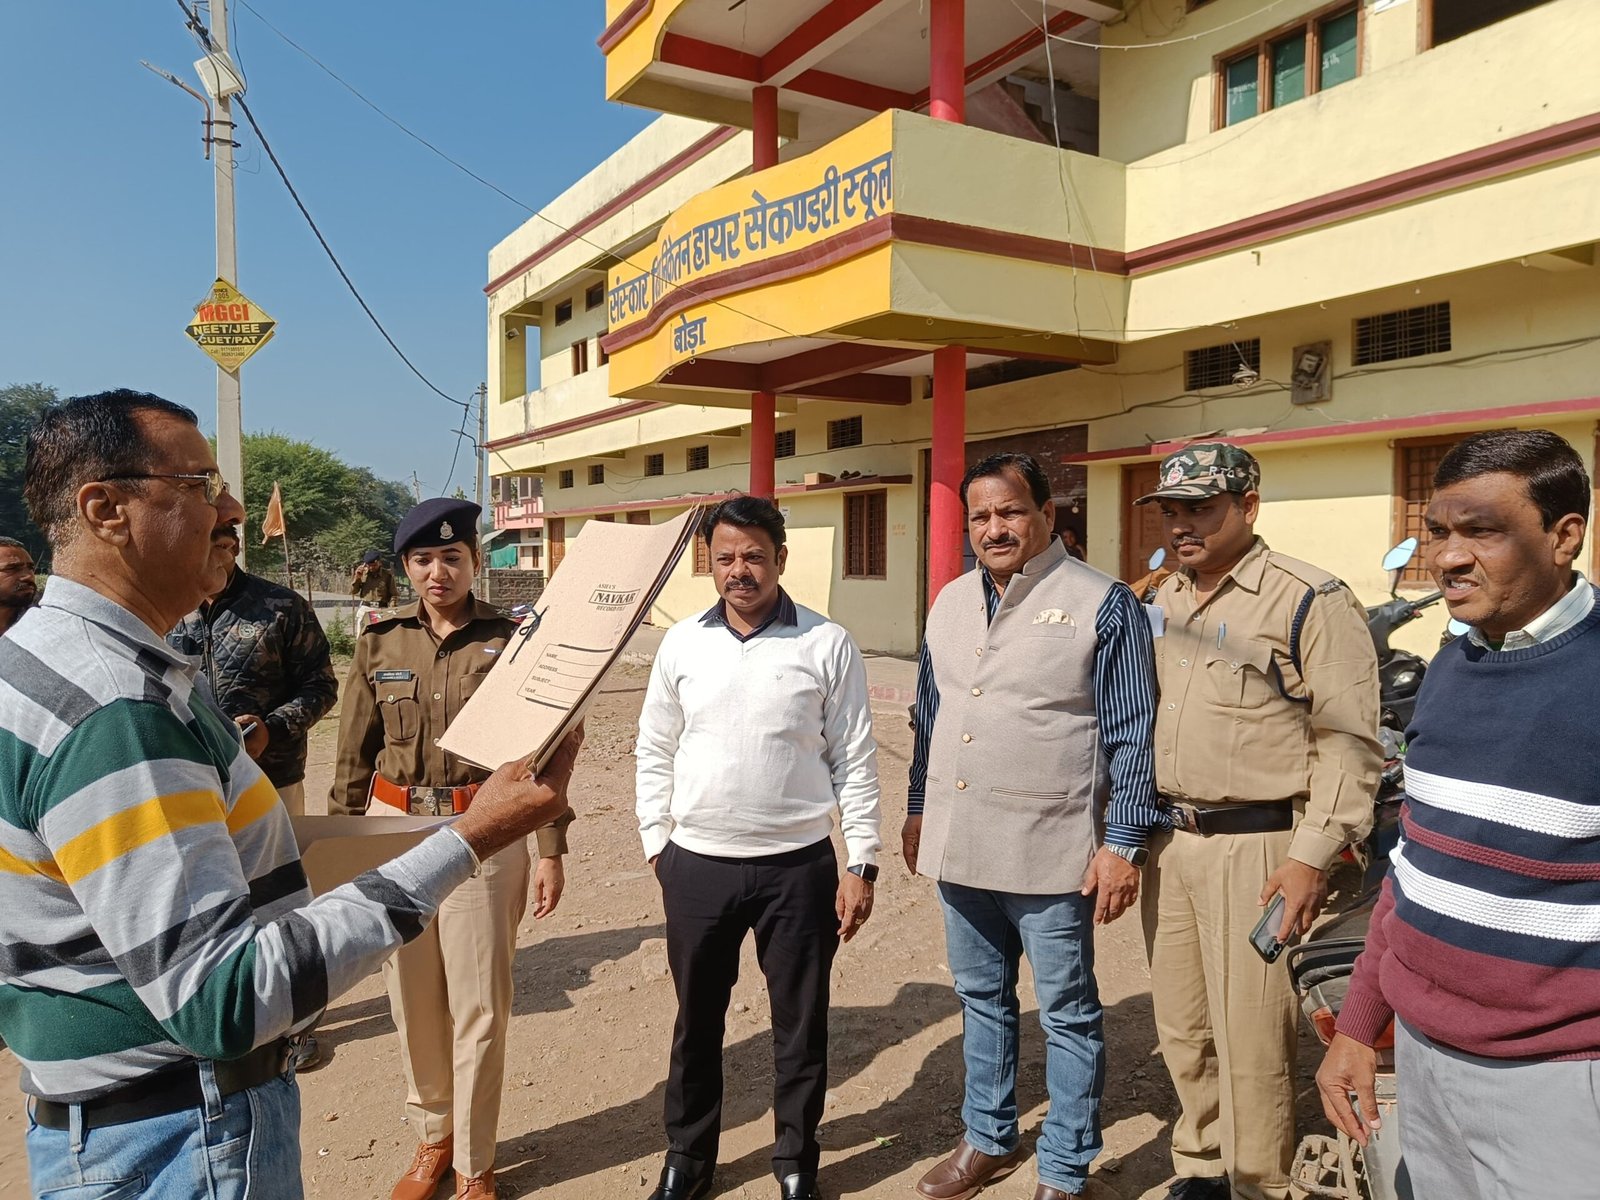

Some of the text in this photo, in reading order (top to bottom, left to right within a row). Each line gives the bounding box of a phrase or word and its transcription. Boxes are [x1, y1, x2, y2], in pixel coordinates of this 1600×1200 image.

[607, 275, 650, 324] संस्कार
[693, 212, 741, 271] हायर
[743, 165, 840, 251] सेकण्डरी
[842, 151, 893, 221] स्कूल
[198, 303, 250, 322] MGCI
[193, 324, 261, 336] NEET/JEE
[673, 313, 708, 354] बोड़ा
[200, 336, 258, 344] CUET/PAT
[593, 592, 637, 604] NAVKAR
[538, 664, 559, 672] ADDRESS
